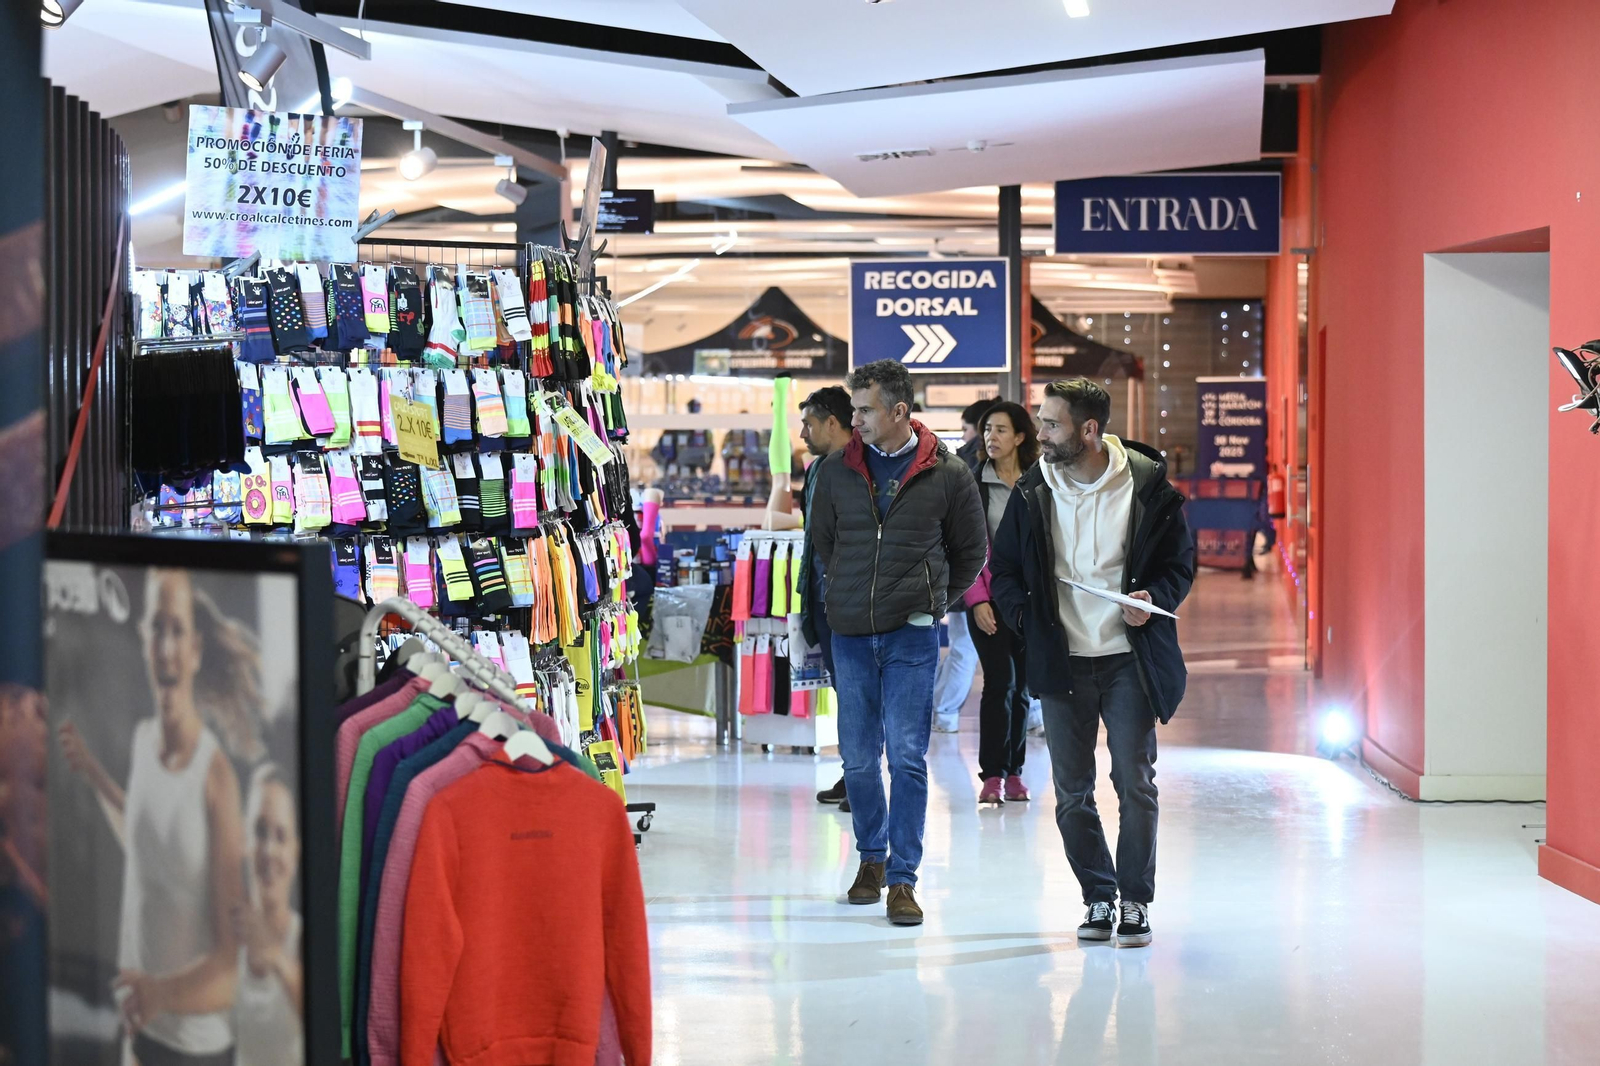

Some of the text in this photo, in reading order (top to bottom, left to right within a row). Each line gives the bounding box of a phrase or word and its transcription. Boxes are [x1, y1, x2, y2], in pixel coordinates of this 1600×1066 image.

[196, 136, 355, 159] PROMOCIÓN DE FERIA
[204, 157, 346, 178] 50% DE DESCUENTO
[237, 185, 312, 208] 2X10€
[192, 210, 353, 228] www.croakcalcetines.com
[1081, 197, 1259, 231] ENTRADA
[864, 270, 997, 290] RECOGIDA
[876, 297, 978, 317] DORSAL
